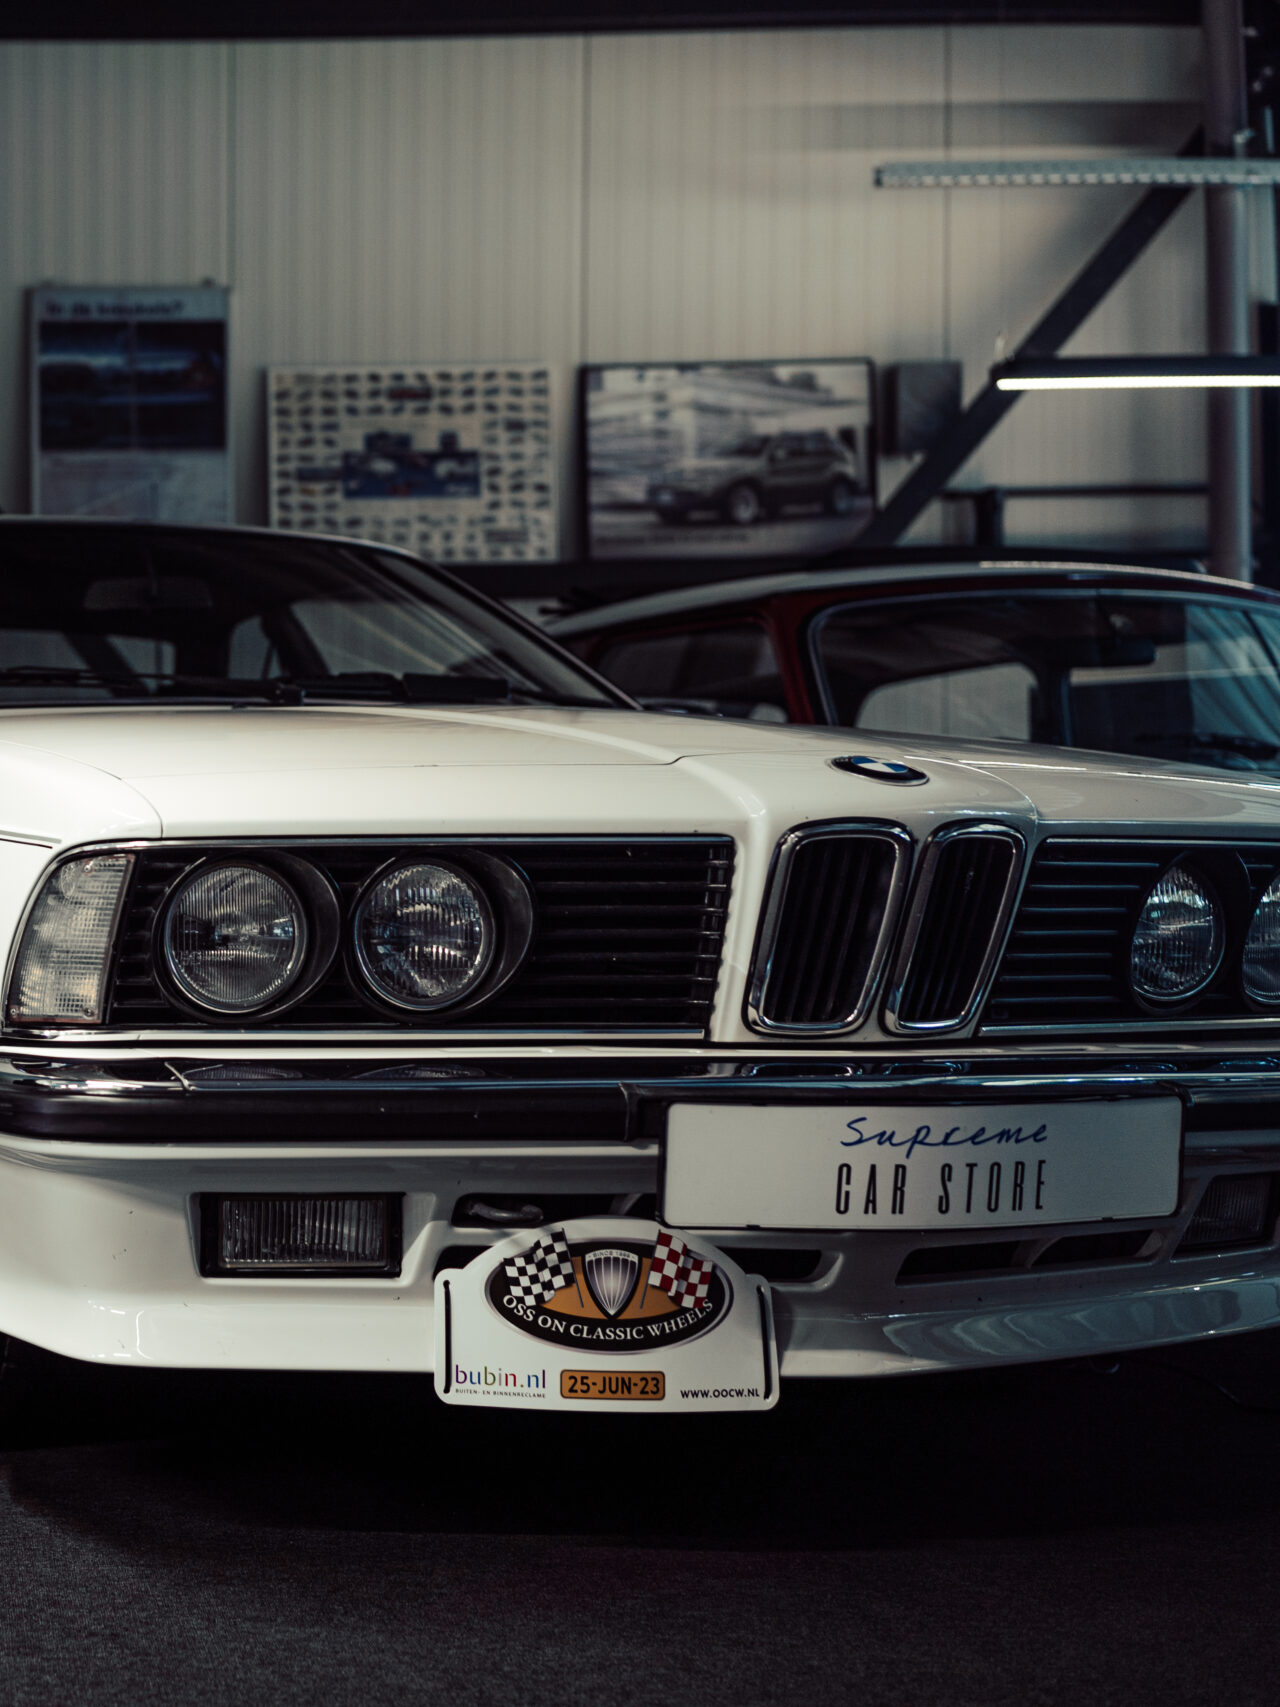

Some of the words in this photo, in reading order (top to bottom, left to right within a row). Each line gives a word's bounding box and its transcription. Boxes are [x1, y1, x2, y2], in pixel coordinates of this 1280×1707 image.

[840, 1116, 1048, 1159] Supreme
[835, 1162, 907, 1215] CAR
[937, 1159, 1047, 1214] STORE
[502, 1293, 537, 1323] OSS
[537, 1314, 567, 1335] ON
[569, 1323, 646, 1341] CLASSIC
[646, 1298, 714, 1338] WHEELS
[454, 1364, 546, 1389] bubin.nl
[567, 1375, 661, 1396] 25-JUN-23
[679, 1388, 760, 1399] WWW.OOCW.NL
